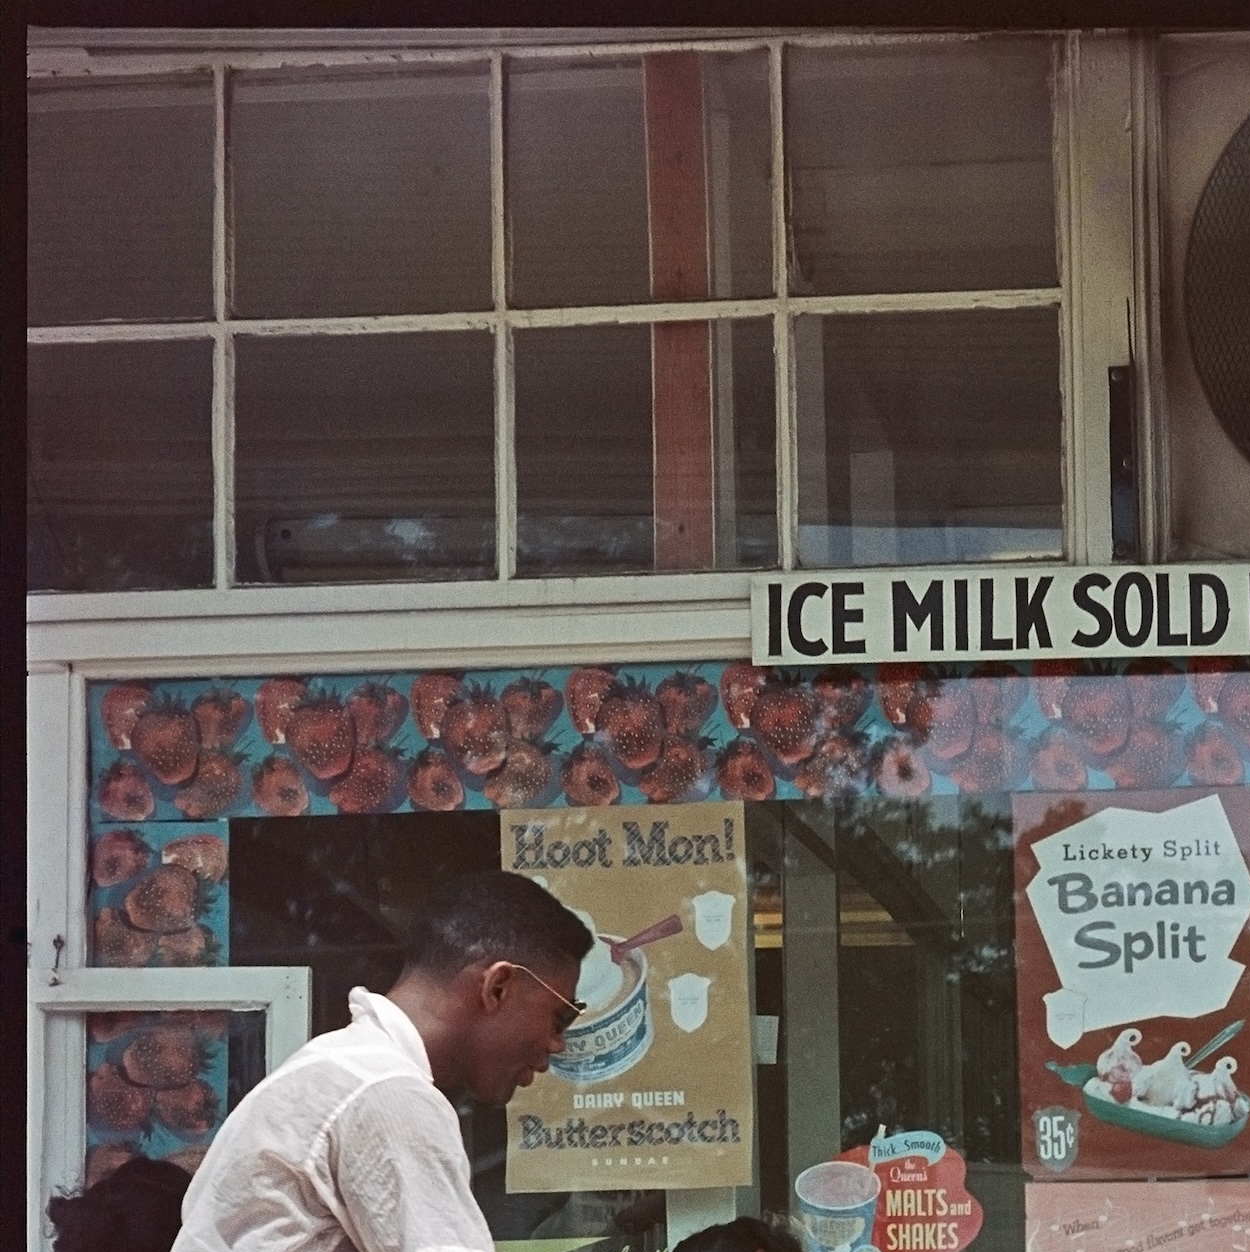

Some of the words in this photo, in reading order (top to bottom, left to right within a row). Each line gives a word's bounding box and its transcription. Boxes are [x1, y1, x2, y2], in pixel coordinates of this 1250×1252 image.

[767, 583, 866, 657] ICE
[892, 576, 1055, 653] MILK
[1071, 572, 1230, 649] SOLD
[511, 823, 613, 870] Hoot
[622, 818, 735, 867] Mon!
[1063, 844, 1152, 862] Lickety
[1163, 840, 1221, 859] Split
[1047, 872, 1236, 914] Banana
[1073, 920, 1207, 973] Split
[573, 1093, 623, 1110] DAIRY
[632, 1090, 685, 1107] QUEEN
[517, 1109, 741, 1151] Butterscotch
[1038, 1115, 1075, 1160] 35¢
[904, 1139, 941, 1154] Smooth
[591, 1156, 669, 1167] SUNDAE
[905, 1159, 915, 1170] the
[886, 1189, 949, 1217] MALTS
[950, 1200, 971, 1216] and
[887, 1223, 959, 1250] SHAKES
[1063, 1219, 1100, 1236] When
[1146, 1228, 1184, 1250] flavors
[1188, 1220, 1206, 1237] get
